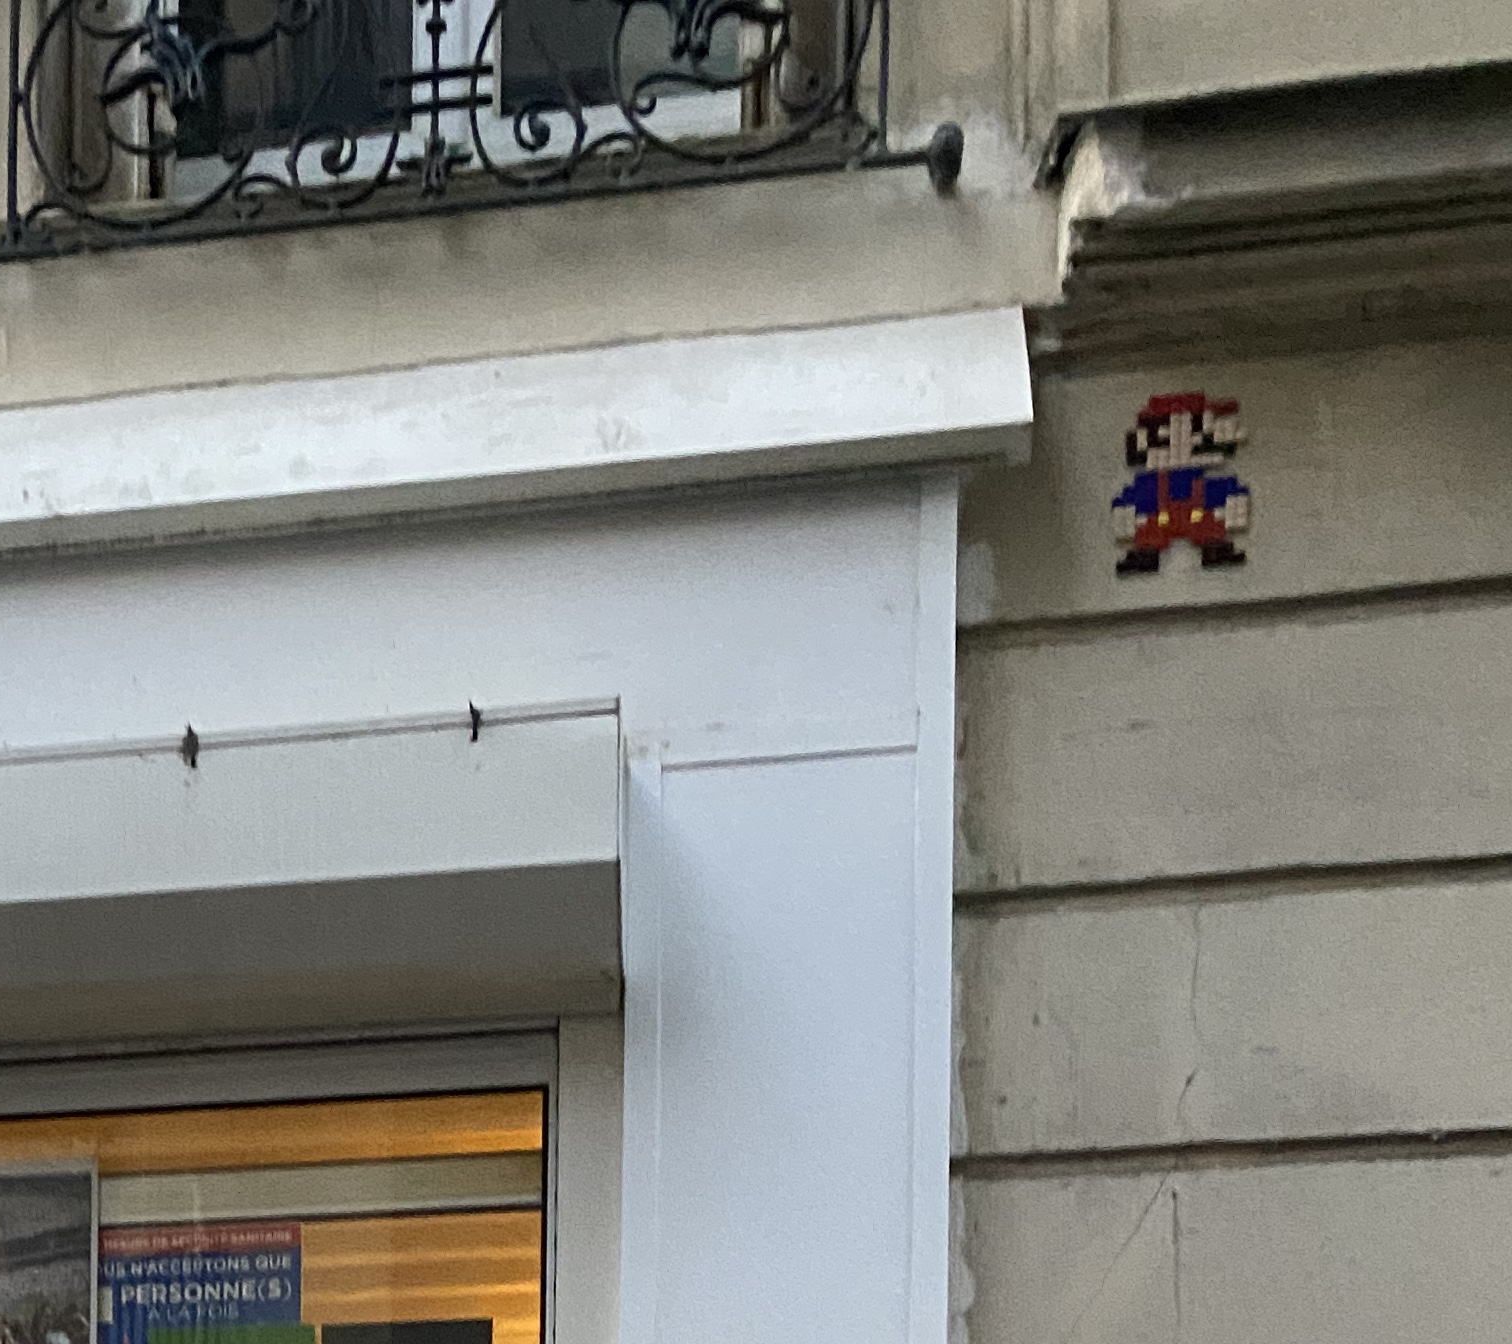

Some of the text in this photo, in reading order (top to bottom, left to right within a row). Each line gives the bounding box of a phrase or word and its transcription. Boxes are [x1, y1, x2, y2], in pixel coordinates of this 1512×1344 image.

[131, 1255, 250, 1277] N'ACCEPTONS
[255, 1253, 292, 1272] QUE
[120, 1276, 293, 1306] PERSONNE(S)
